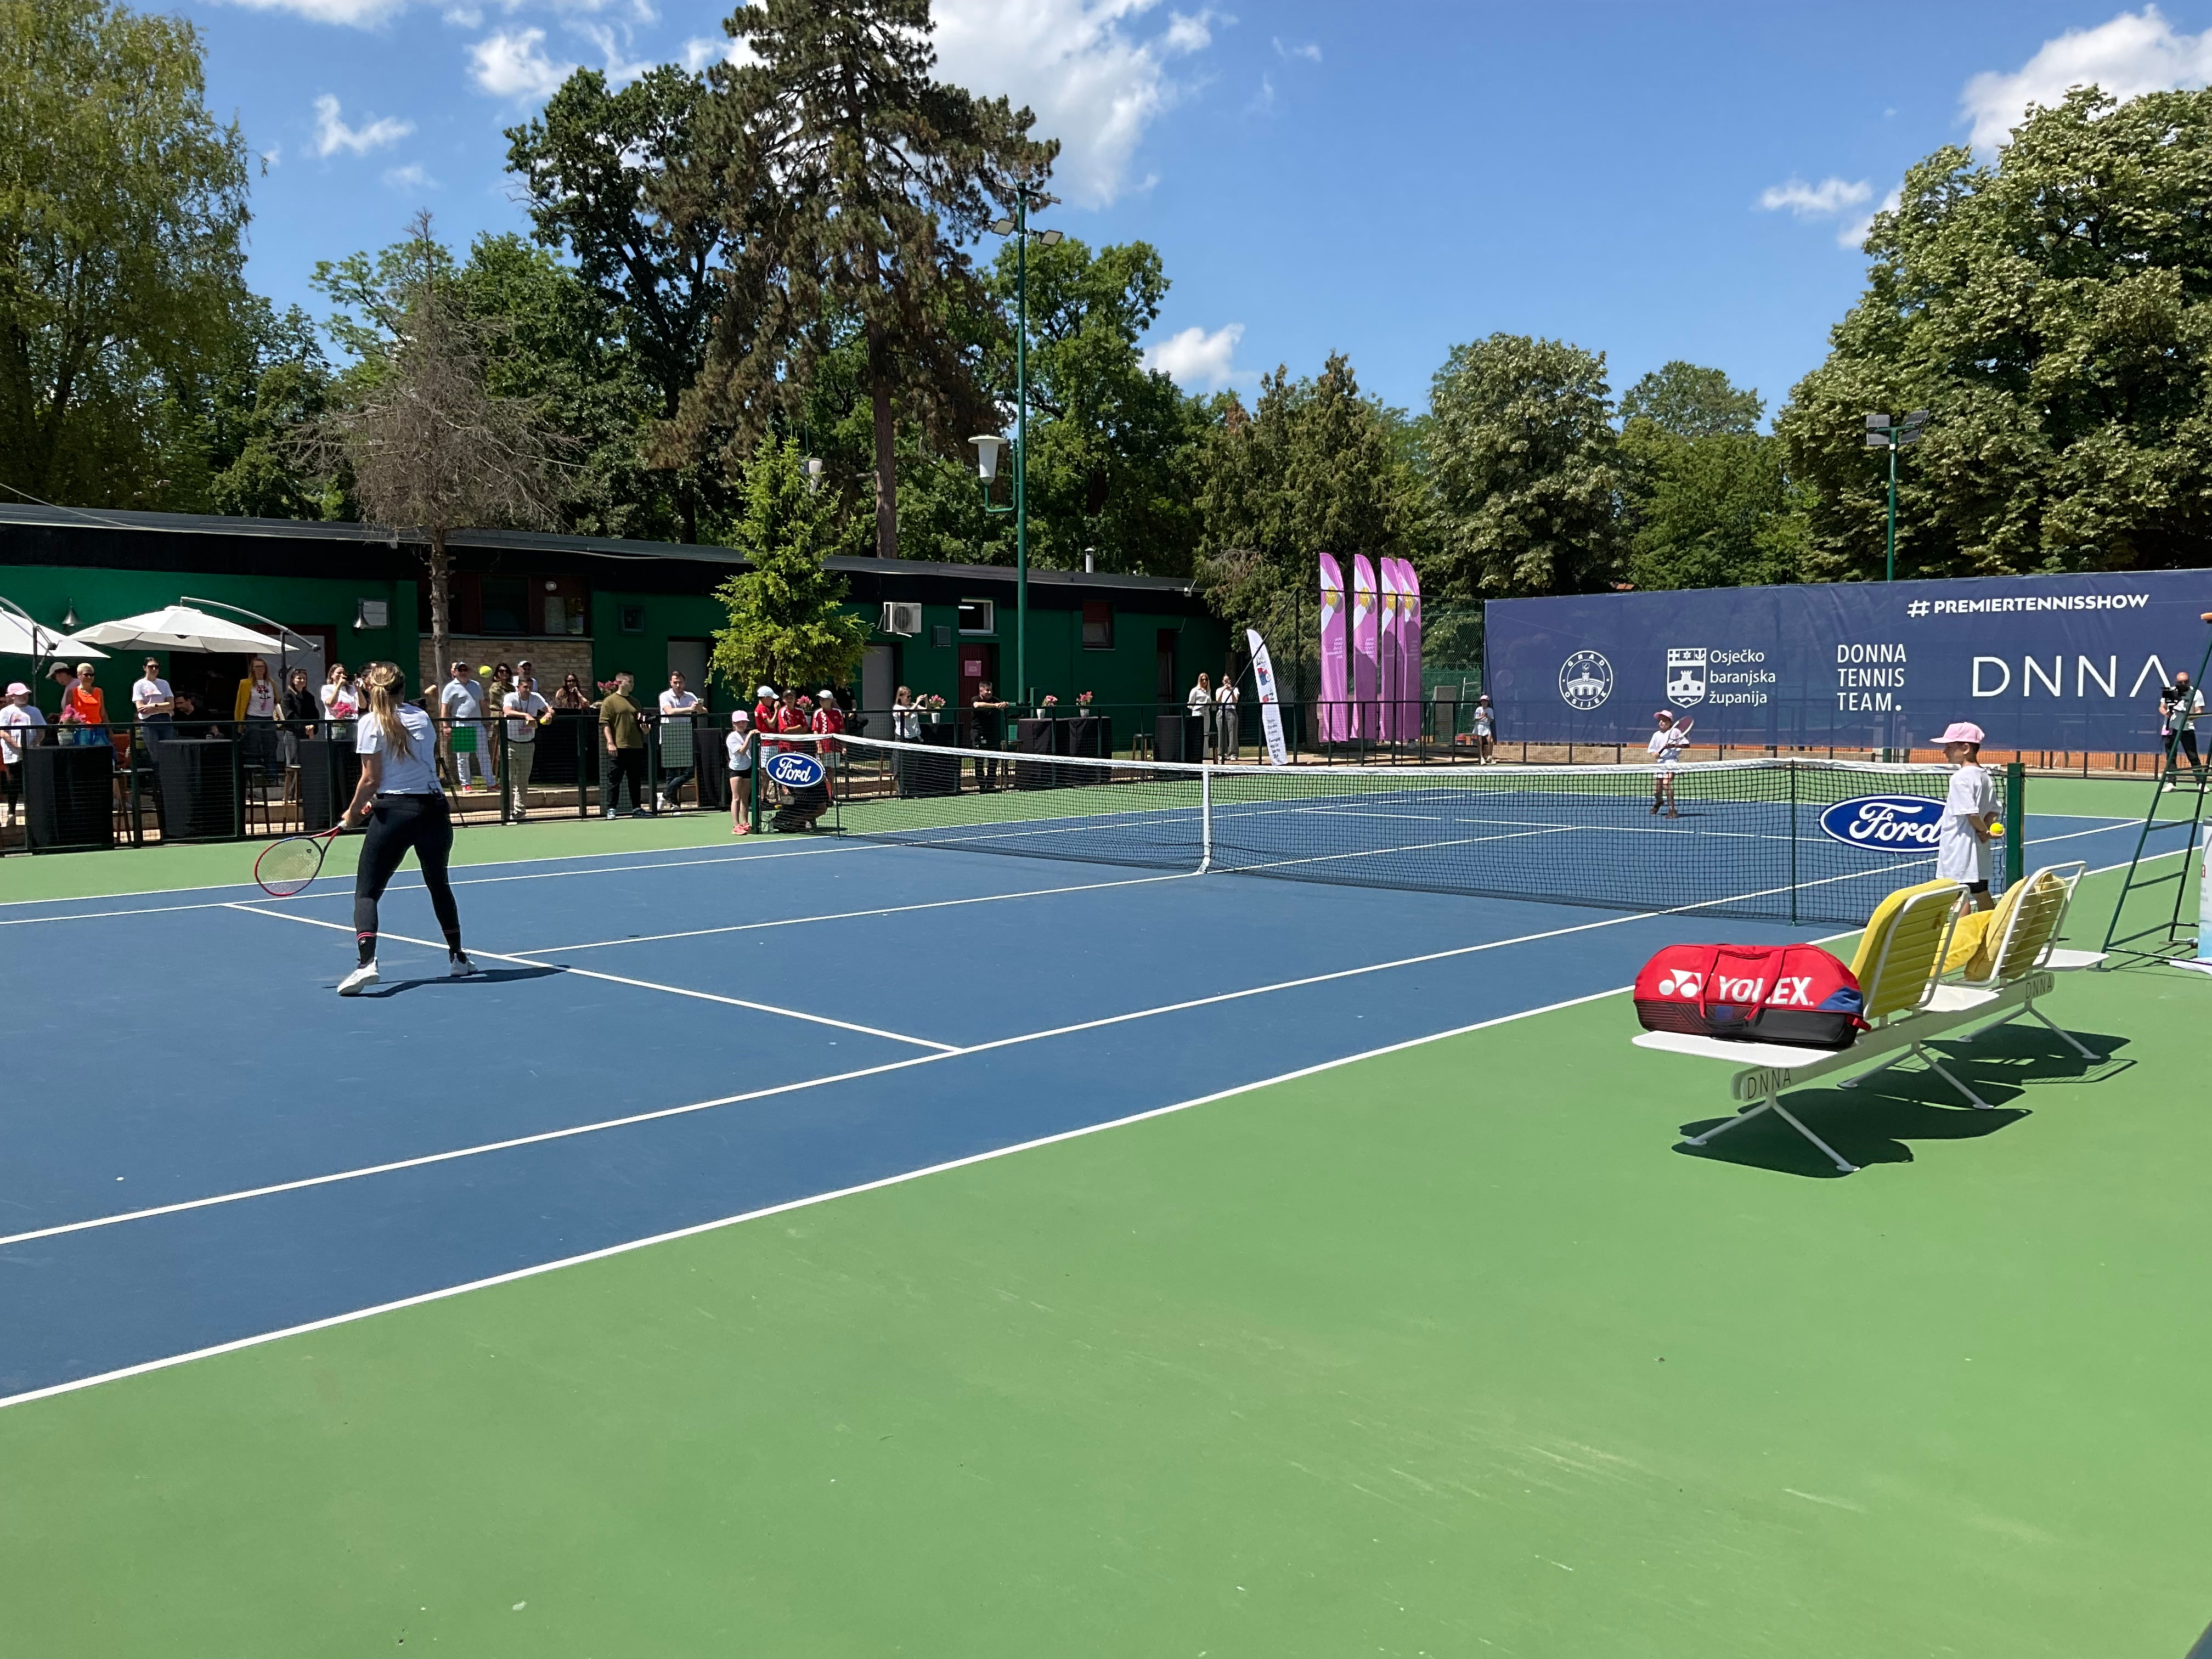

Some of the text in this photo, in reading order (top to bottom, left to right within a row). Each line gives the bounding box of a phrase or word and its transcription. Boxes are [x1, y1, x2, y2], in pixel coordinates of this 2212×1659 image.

[1567, 653, 1605, 667] GRAD
[1710, 648, 1765, 666] Osječko
[1837, 644, 1906, 663] DONNA
[1710, 669, 1776, 686] baranjska
[1837, 668, 1905, 687] TENNIS
[1565, 691, 1607, 708] OSIJEK
[1708, 690, 1767, 707] županija
[1837, 692, 1902, 711] TEAM.
[776, 757, 812, 782] Ford
[2025, 975, 2052, 999] DNNA
[1747, 1068, 1791, 1099] DNNA
